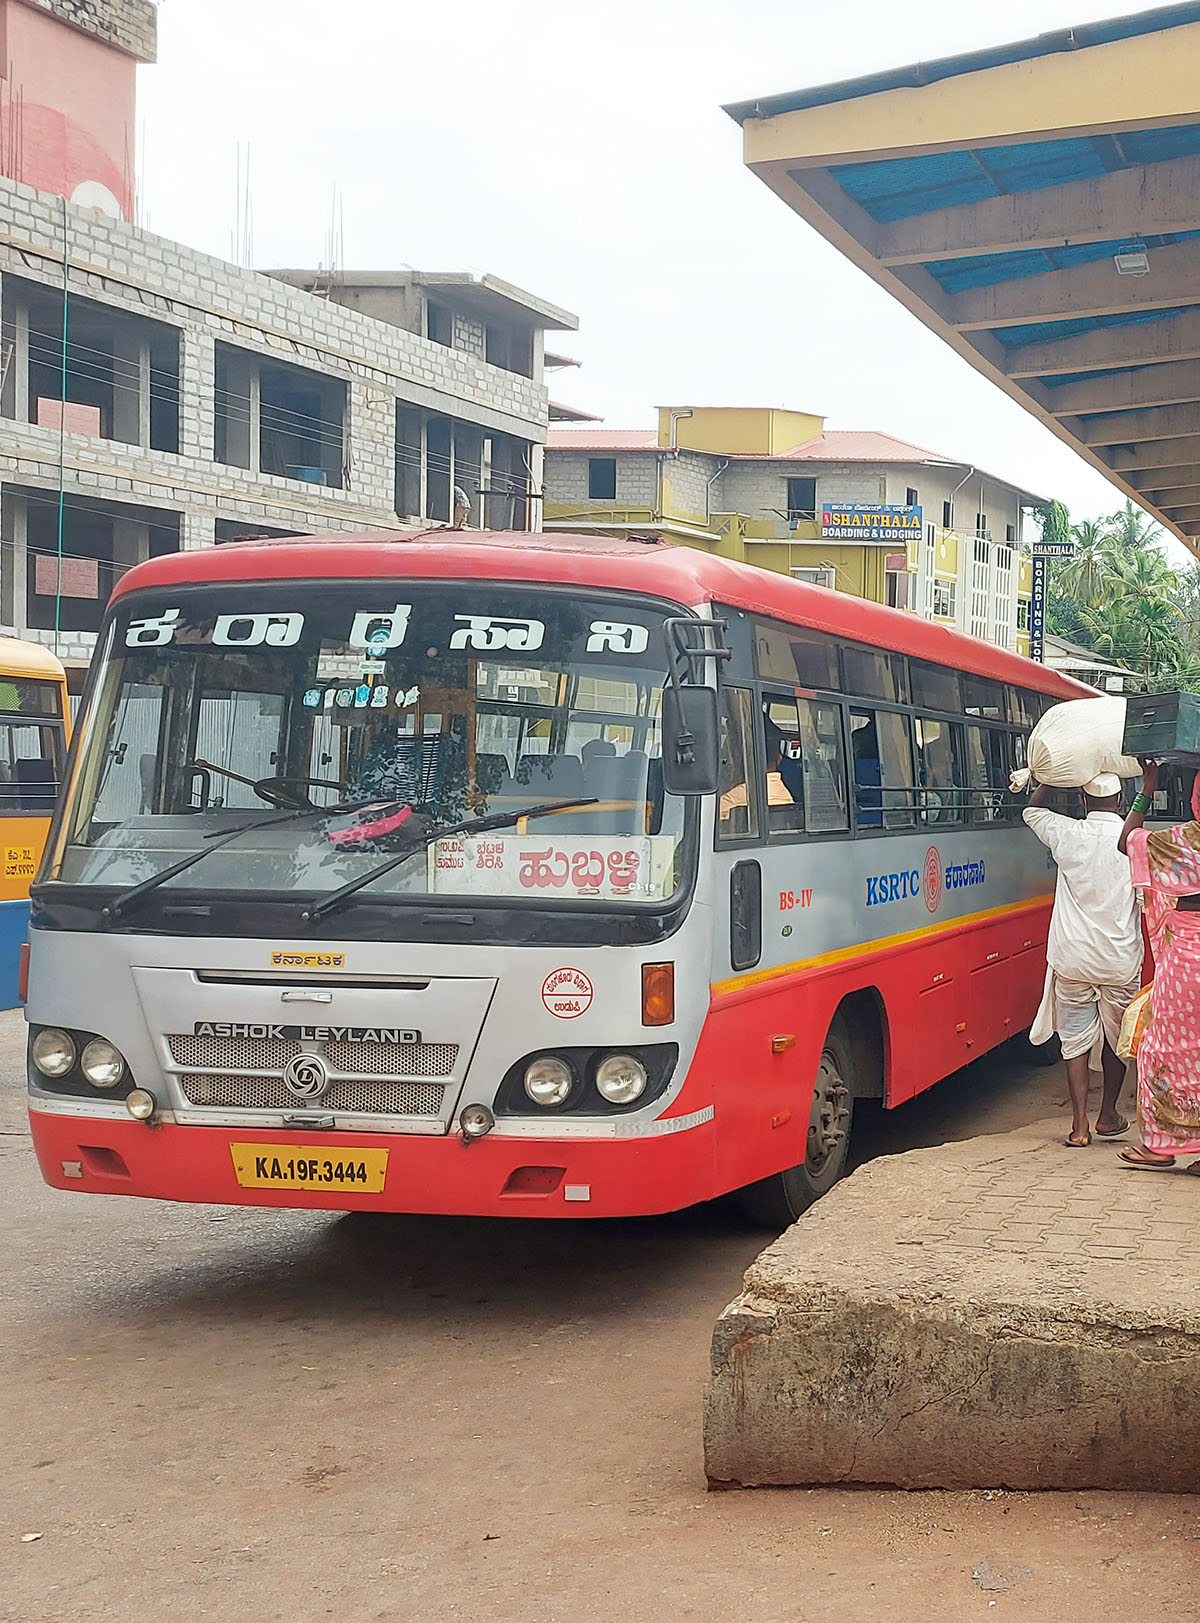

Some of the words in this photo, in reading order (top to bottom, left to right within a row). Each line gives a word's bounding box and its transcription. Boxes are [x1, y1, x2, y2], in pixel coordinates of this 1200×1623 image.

[832, 513, 920, 528] SHANTHALA
[822, 527, 870, 538] BOARDING
[871, 528, 878, 538] &
[880, 529, 922, 539] LODGING
[1033, 545, 1073, 555] SHANTHALA
[1034, 561, 1042, 626] BOARDING
[1033, 630, 1041, 638] &
[945, 859, 986, 890] ಕರಾರಸಾನಿ
[866, 870, 920, 906] KSRTC
[273, 953, 343, 967] ಕರ್ನಾಟಕ
[197, 1023, 285, 1039] ASHOK
[300, 1027, 418, 1044] LEYLAND
[255, 1156, 368, 1183] KA.19F.3444
